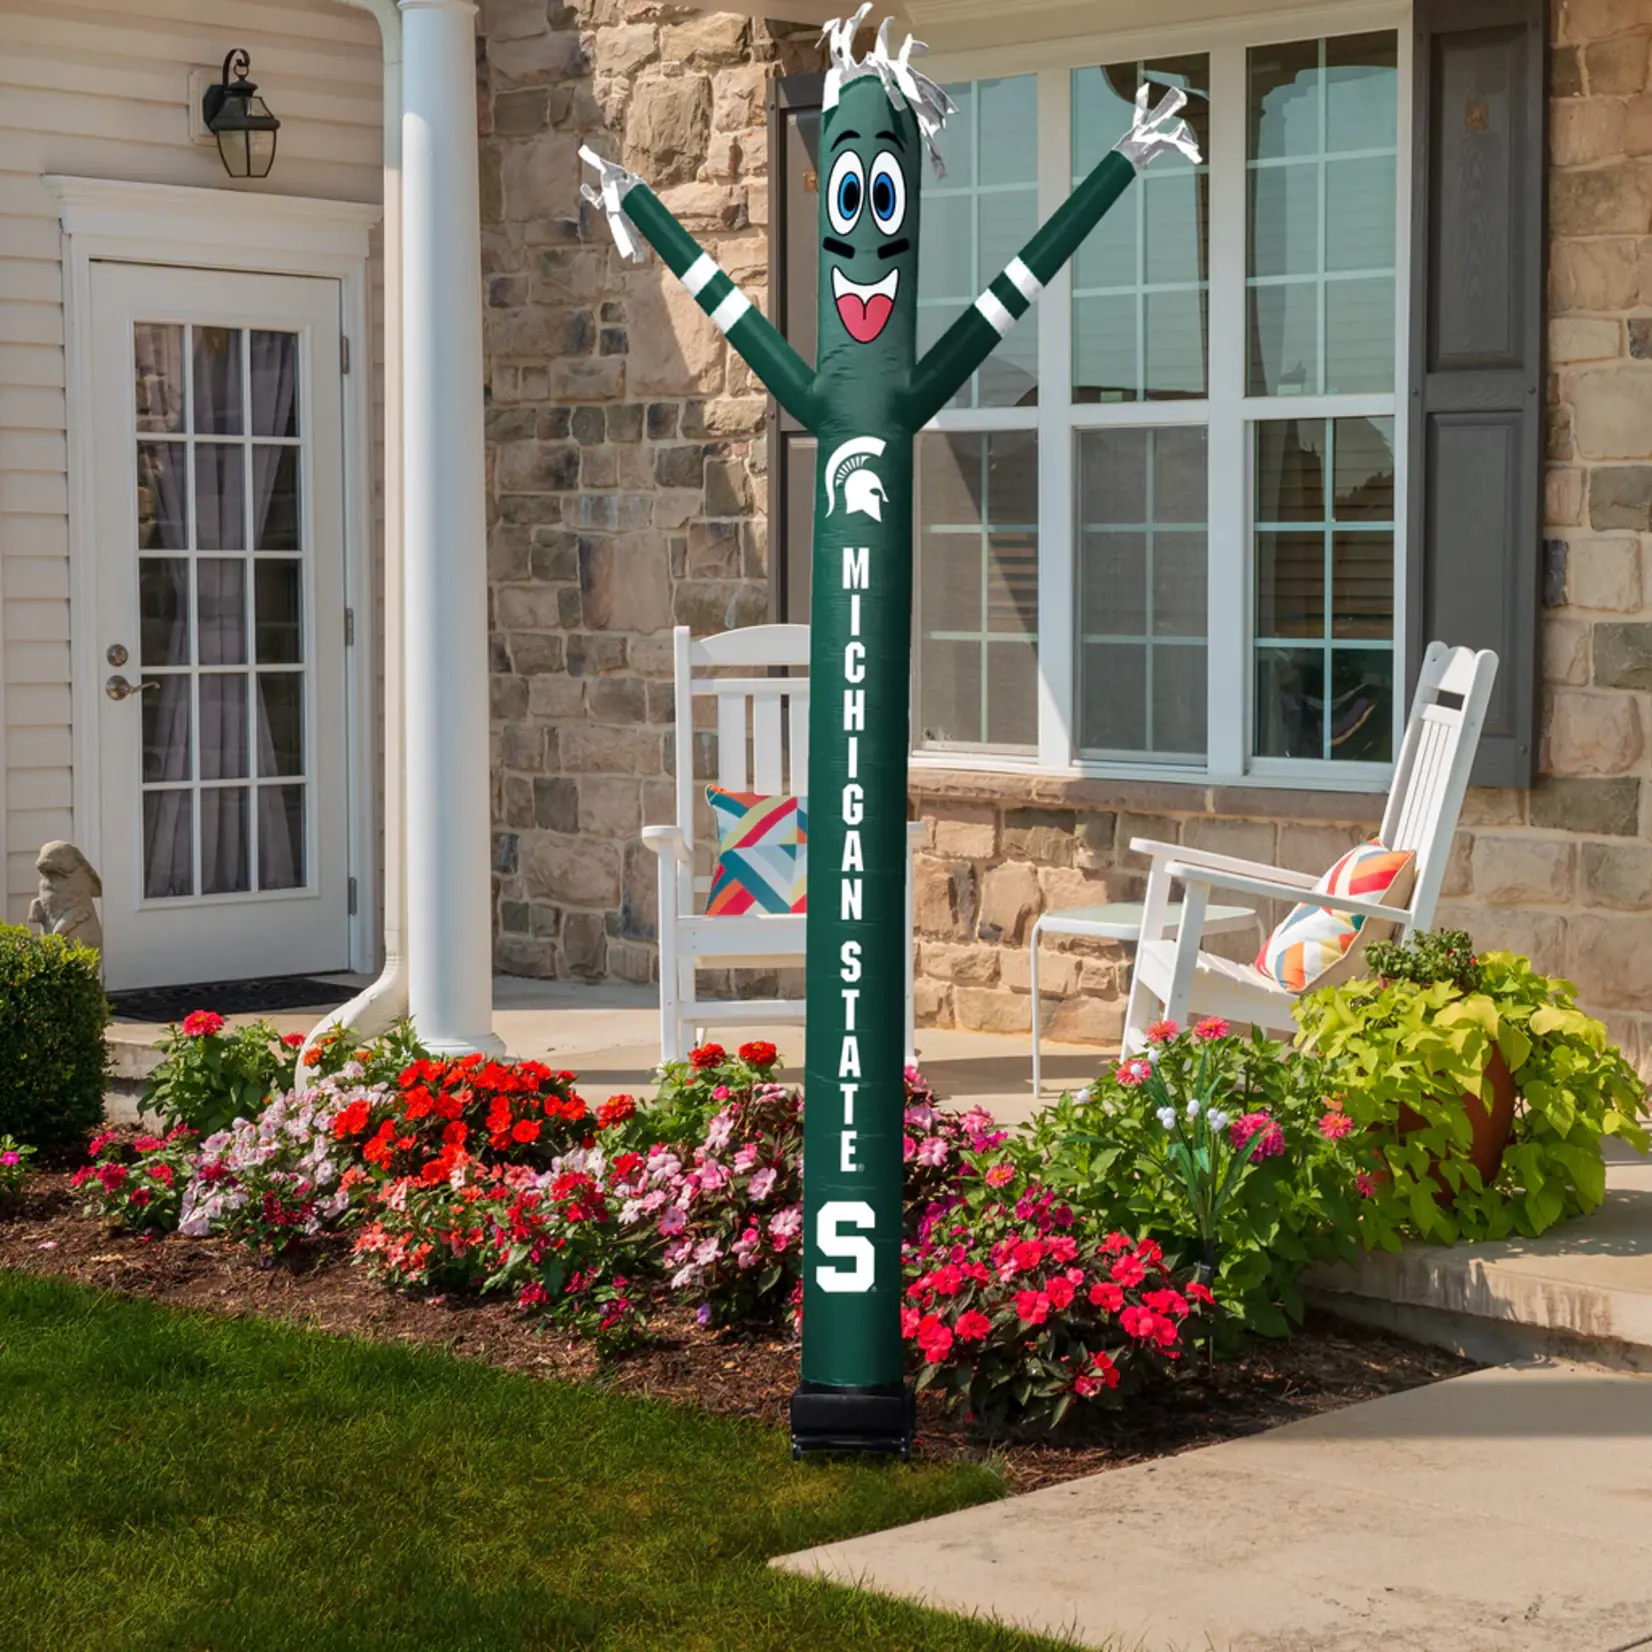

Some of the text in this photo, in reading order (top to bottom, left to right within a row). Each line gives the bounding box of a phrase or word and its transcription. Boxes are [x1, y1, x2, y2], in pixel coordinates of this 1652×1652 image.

[839, 547, 870, 1172] MICHIGAN STATE
[816, 1201, 875, 1292] S
